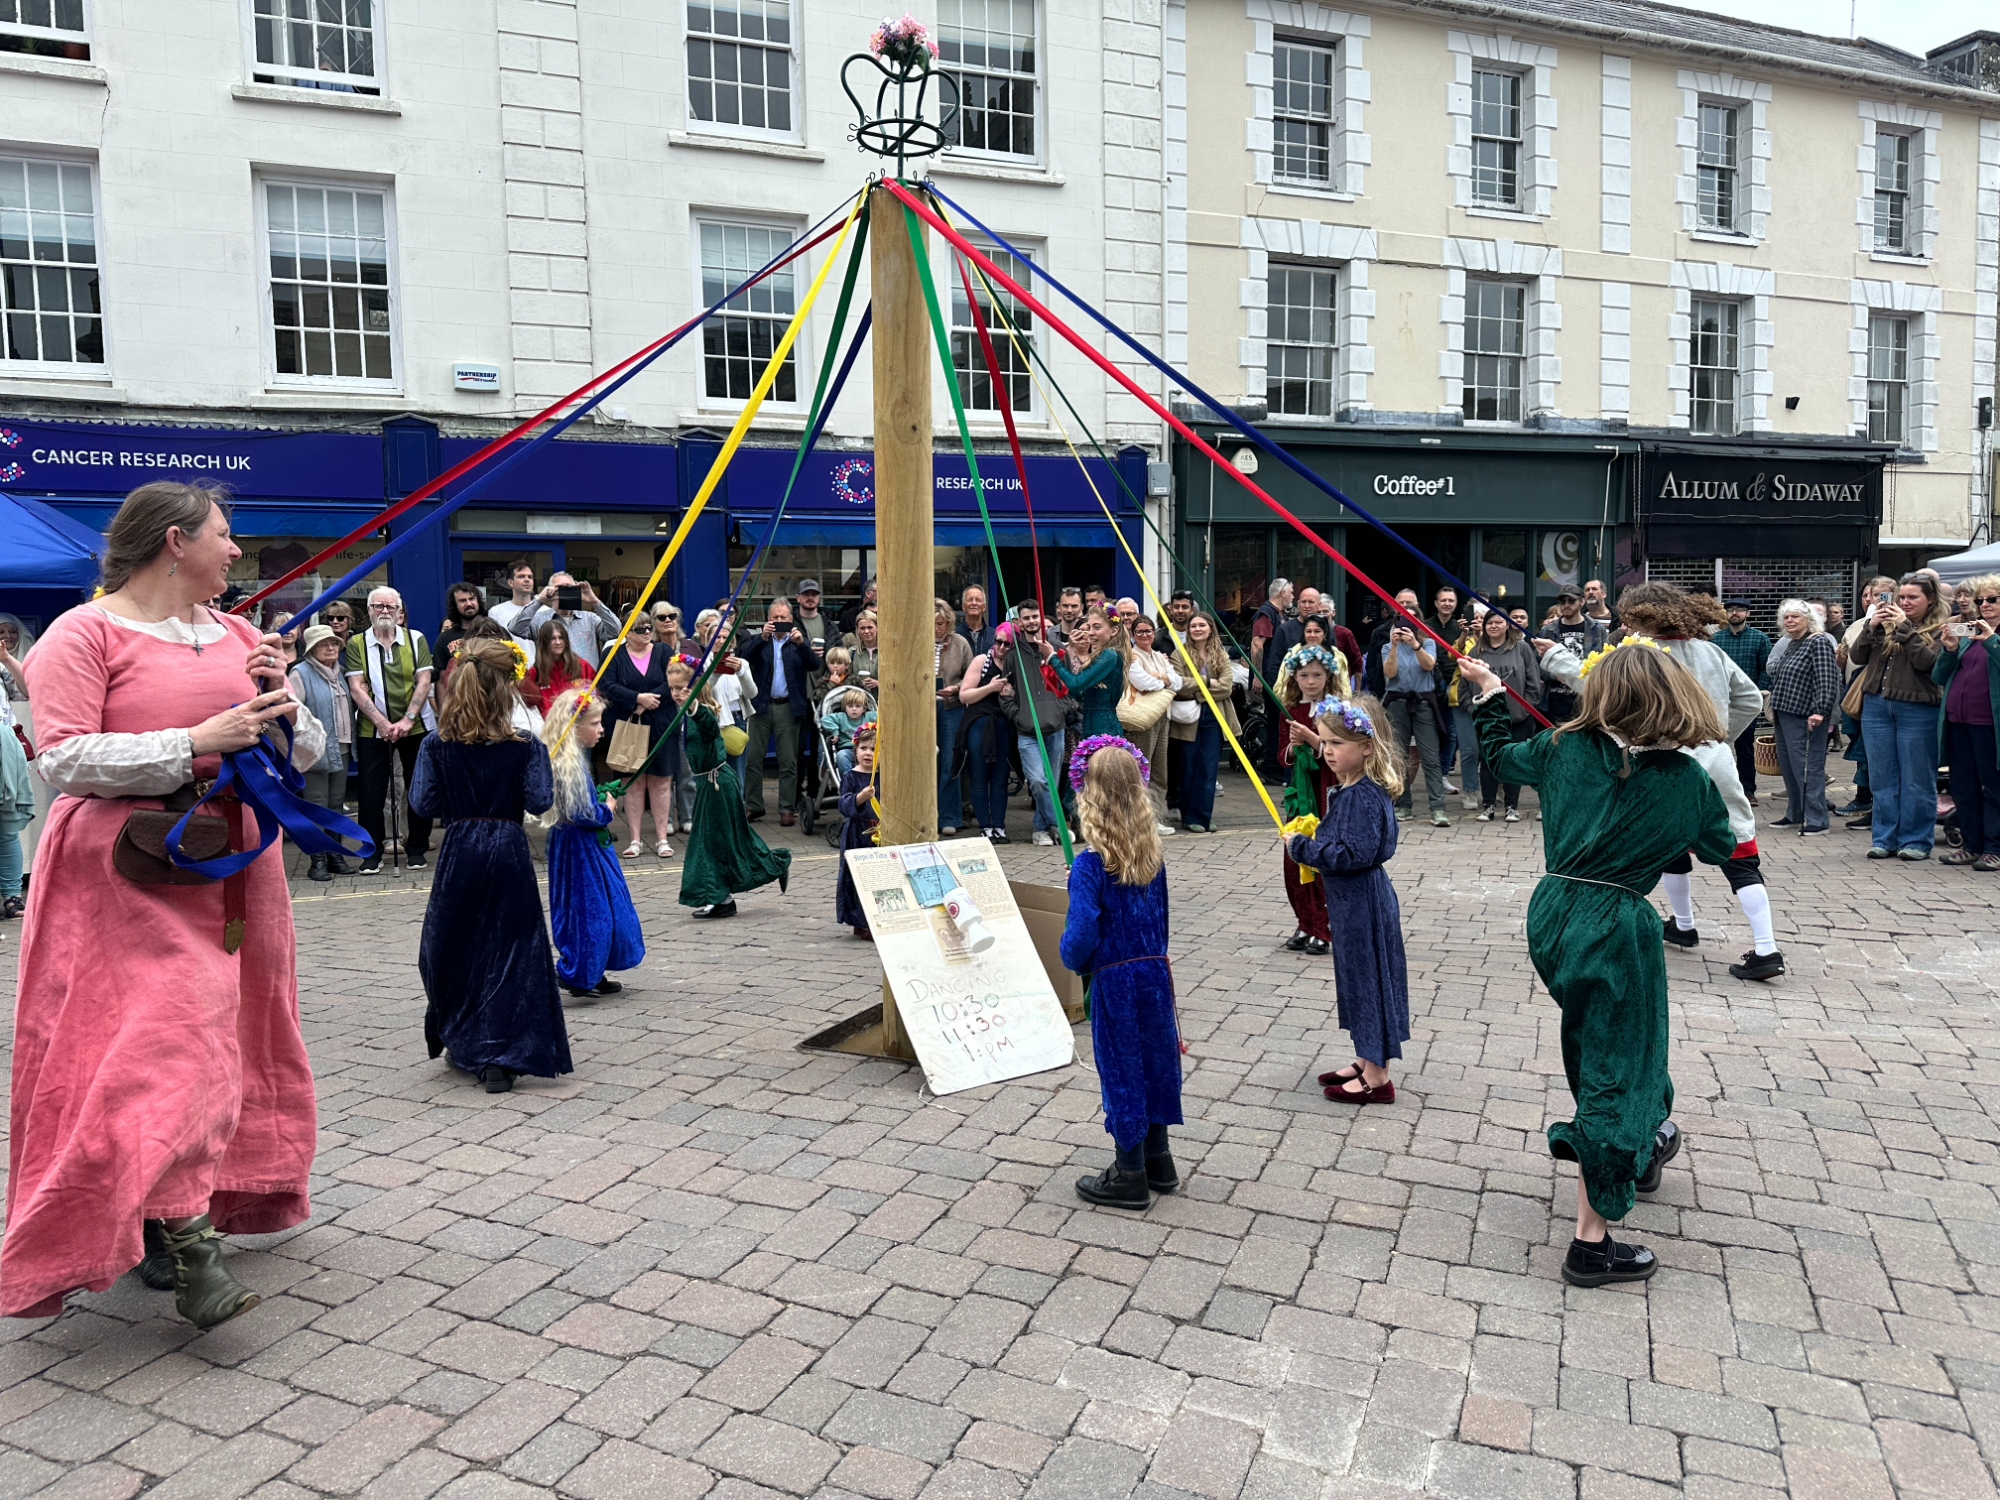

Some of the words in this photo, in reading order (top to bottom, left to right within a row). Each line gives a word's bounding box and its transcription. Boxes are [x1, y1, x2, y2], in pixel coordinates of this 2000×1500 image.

[457, 370, 497, 379] PARTNERSHIP
[32, 449, 114, 466] CANCER
[120, 452, 220, 469] RESEARCH
[226, 455, 251, 470] UK
[936, 477, 1003, 490] RESEARCH
[1006, 478, 1024, 490] UK
[1658, 471, 1740, 500] ALLUM
[1745, 472, 1766, 501] &
[1771, 474, 1865, 502] SIDAWAY
[906, 970, 1006, 1004] DANCING
[932, 993, 1000, 1023] 10:30
[942, 1014, 1006, 1044] 11:30
